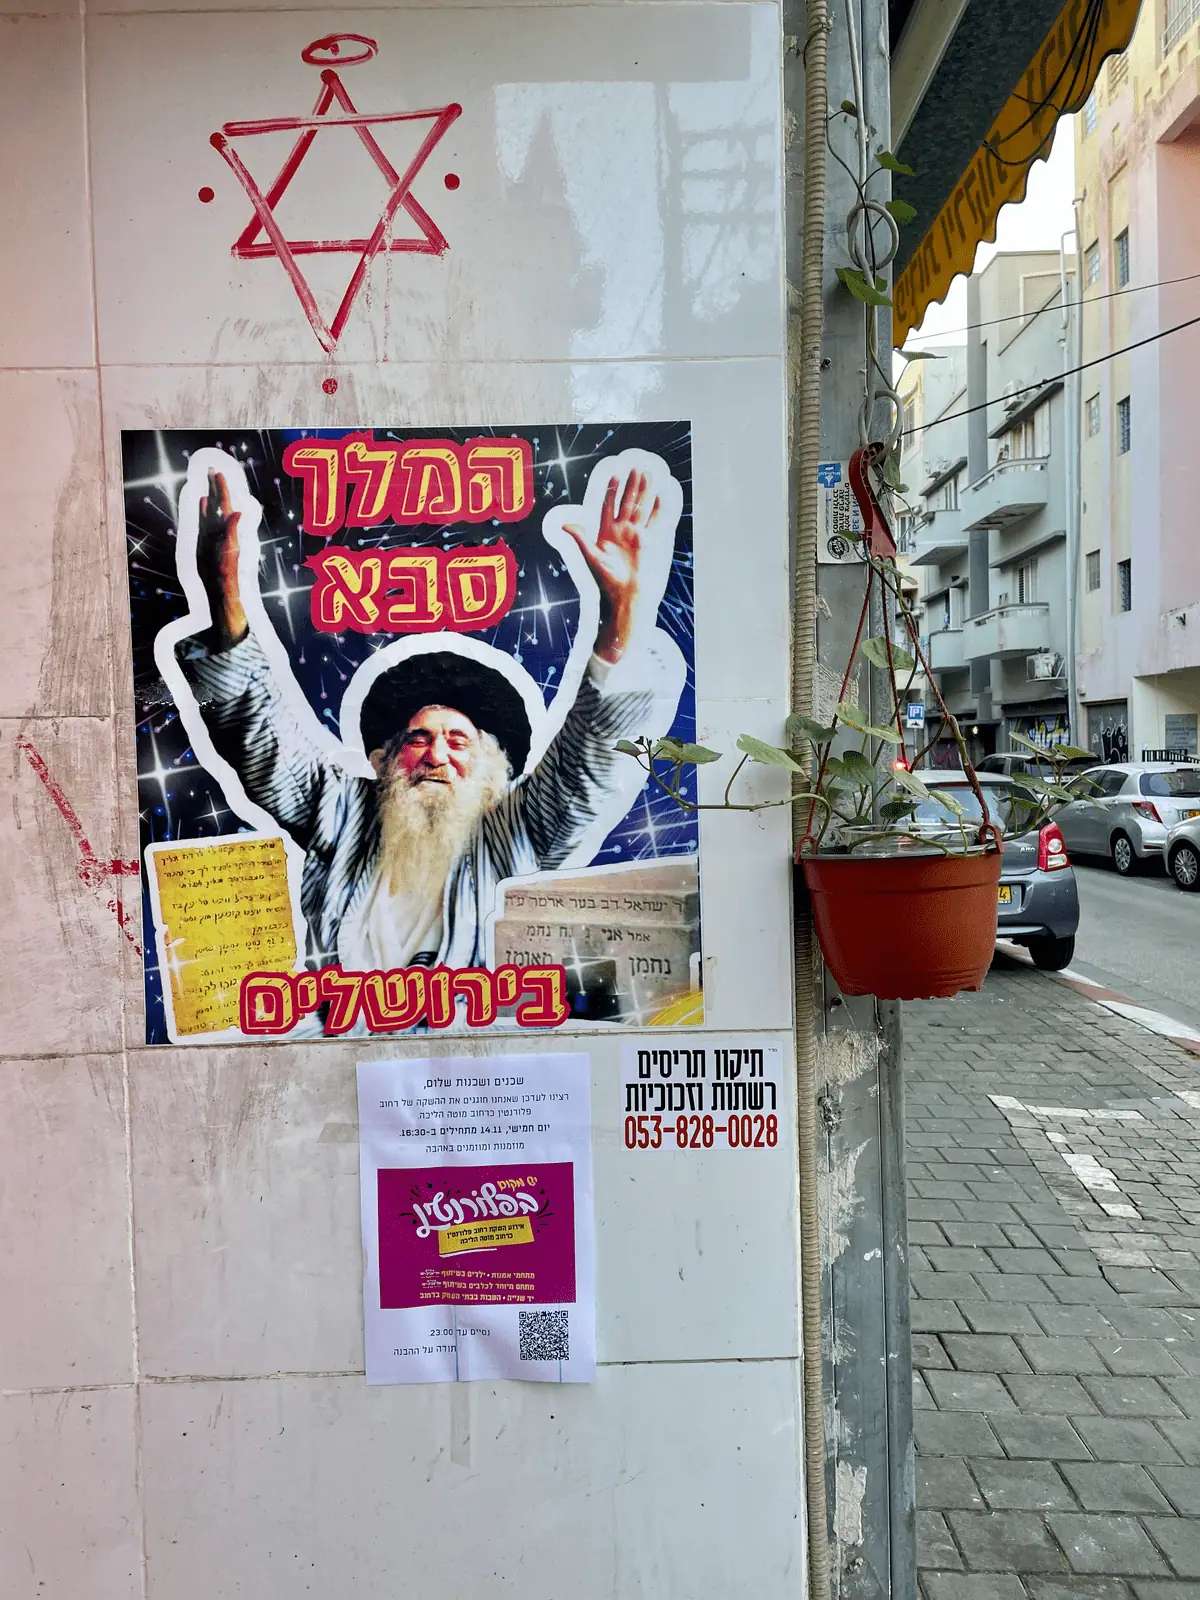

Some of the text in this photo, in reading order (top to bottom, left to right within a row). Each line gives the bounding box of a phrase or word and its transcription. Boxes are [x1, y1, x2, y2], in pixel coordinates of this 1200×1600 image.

[290, 440, 526, 528] המלך
[319, 553, 508, 626] סבא
[569, 898, 596, 909] בער
[601, 899, 619, 910] דב
[624, 898, 668, 912] ישראל
[601, 928, 622, 941] אני
[626, 931, 651, 942] אמר
[628, 955, 672, 977] נחמן
[245, 968, 566, 1031] בירושלים
[637, 1049, 763, 1080] תיקון תריסים
[423, 1076, 524, 1089] שכנים ושכנות שלום,
[379, 1092, 569, 1108] רצינו לעדכן שאנחנו חוגגים את ההשקה של רחוב
[625, 1081, 777, 1112] רשתות וזכוכיות
[448, 1110, 467, 1118] מוטה
[470, 1109, 495, 1117] כרחוב
[498, 1107, 532, 1118] פלורנטין
[440, 1125, 477, 1136] מתחילים
[480, 1125, 502, 1134] 14.11
[505, 1123, 535, 1135] חמישי,
[538, 1123, 550, 1132] יום
[624, 1113, 778, 1149] 053-828-0028
[425, 1142, 525, 1153] מוזמנות ומוזמנים באהבה
[497, 1175, 538, 1192] יש מקום
[412, 1182, 539, 1239] בפלורנטין
[489, 1225, 507, 1233] השקת
[508, 1223, 525, 1231] אירוע
[447, 1229, 472, 1239] פלורנטין
[479, 1234, 494, 1242] מוטה
[460, 1236, 478, 1245] הליכה
[441, 1269, 465, 1278] בשיתוף
[467, 1270, 486, 1278] ילדים
[491, 1271, 512, 1279] אמנות
[513, 1271, 535, 1279] מתחמי
[442, 1280, 467, 1289] בשיתוף
[468, 1281, 493, 1290] לכלבים
[495, 1282, 514, 1290] מיוחד
[515, 1283, 535, 1291] מתחם
[507, 1294, 526, 1302] שנייה
[428, 1328, 491, 1338] נסיים עד 23:00.
[393, 1344, 457, 1356] תודה על ההבנה
